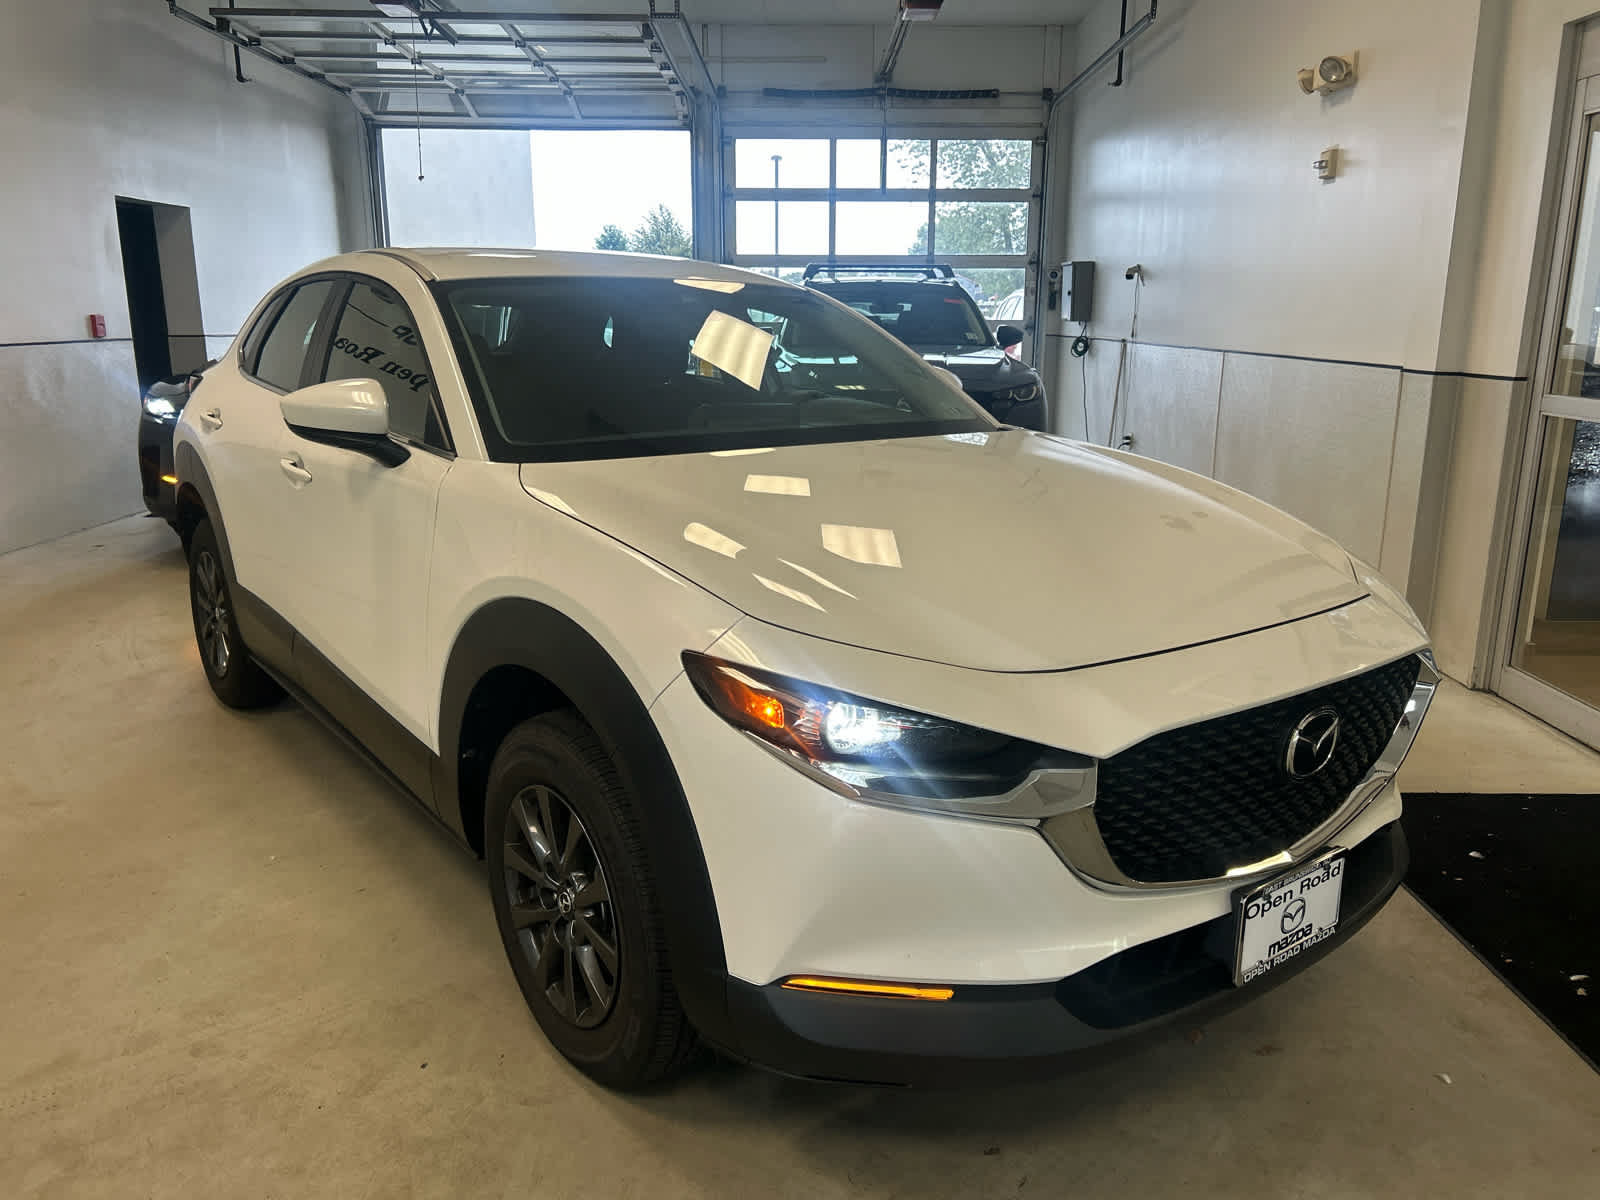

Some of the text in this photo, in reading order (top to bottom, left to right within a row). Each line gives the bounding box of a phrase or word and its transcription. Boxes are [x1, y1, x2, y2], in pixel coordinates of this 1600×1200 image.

[1246, 889, 1294, 919] Open
[1300, 861, 1341, 895] Road
[1243, 926, 1336, 983] OPEN ROAD MAZDA
